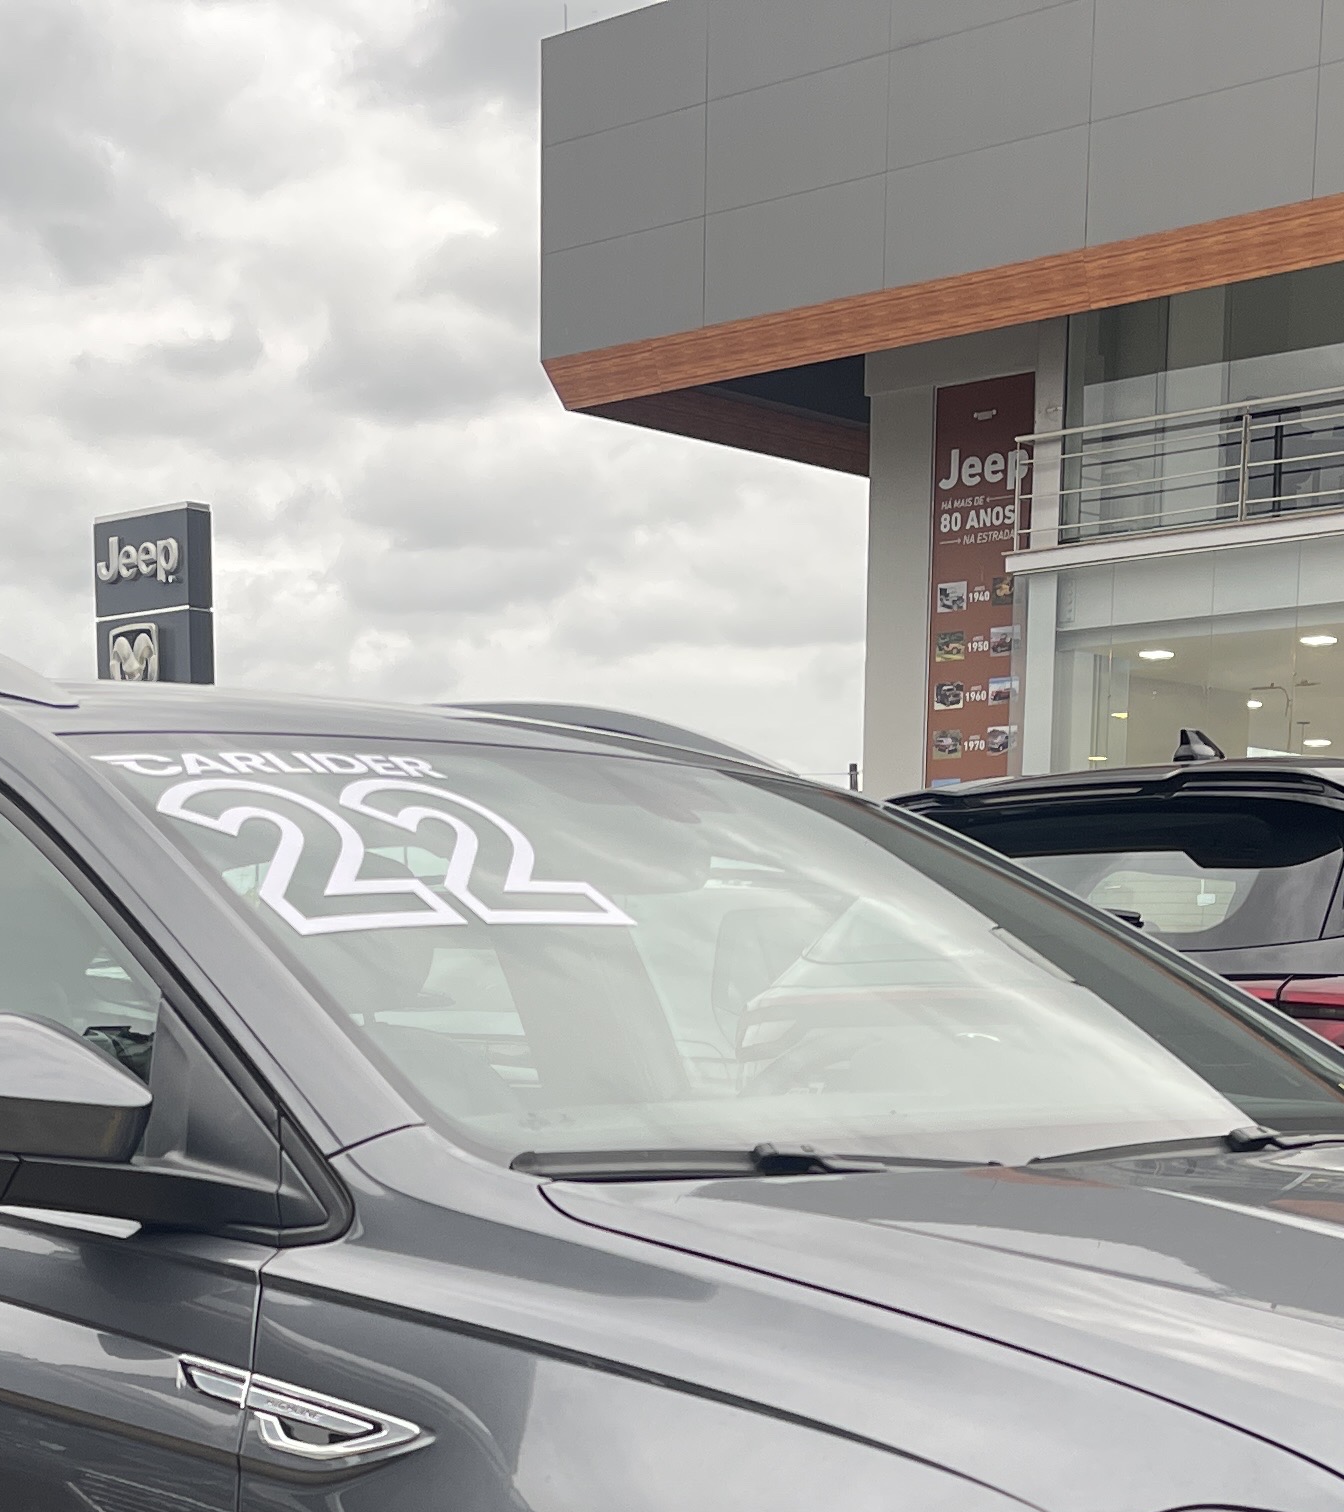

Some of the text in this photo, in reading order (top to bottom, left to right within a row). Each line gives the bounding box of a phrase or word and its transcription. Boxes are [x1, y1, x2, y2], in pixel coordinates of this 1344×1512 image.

[939, 449, 1029, 490] Jeep
[954, 496, 973, 508] MAIS
[973, 495, 986, 506] DE
[940, 505, 1015, 533] 80 ANOS
[963, 529, 1015, 545] NA ESTRADA
[96, 536, 179, 583] Jeep
[969, 591, 990, 603] 1940
[967, 641, 989, 653] 1950
[965, 690, 987, 702] 1960
[963, 740, 985, 752] 1970
[90, 752, 447, 780] CARLIDER
[157, 778, 637, 936] 22
